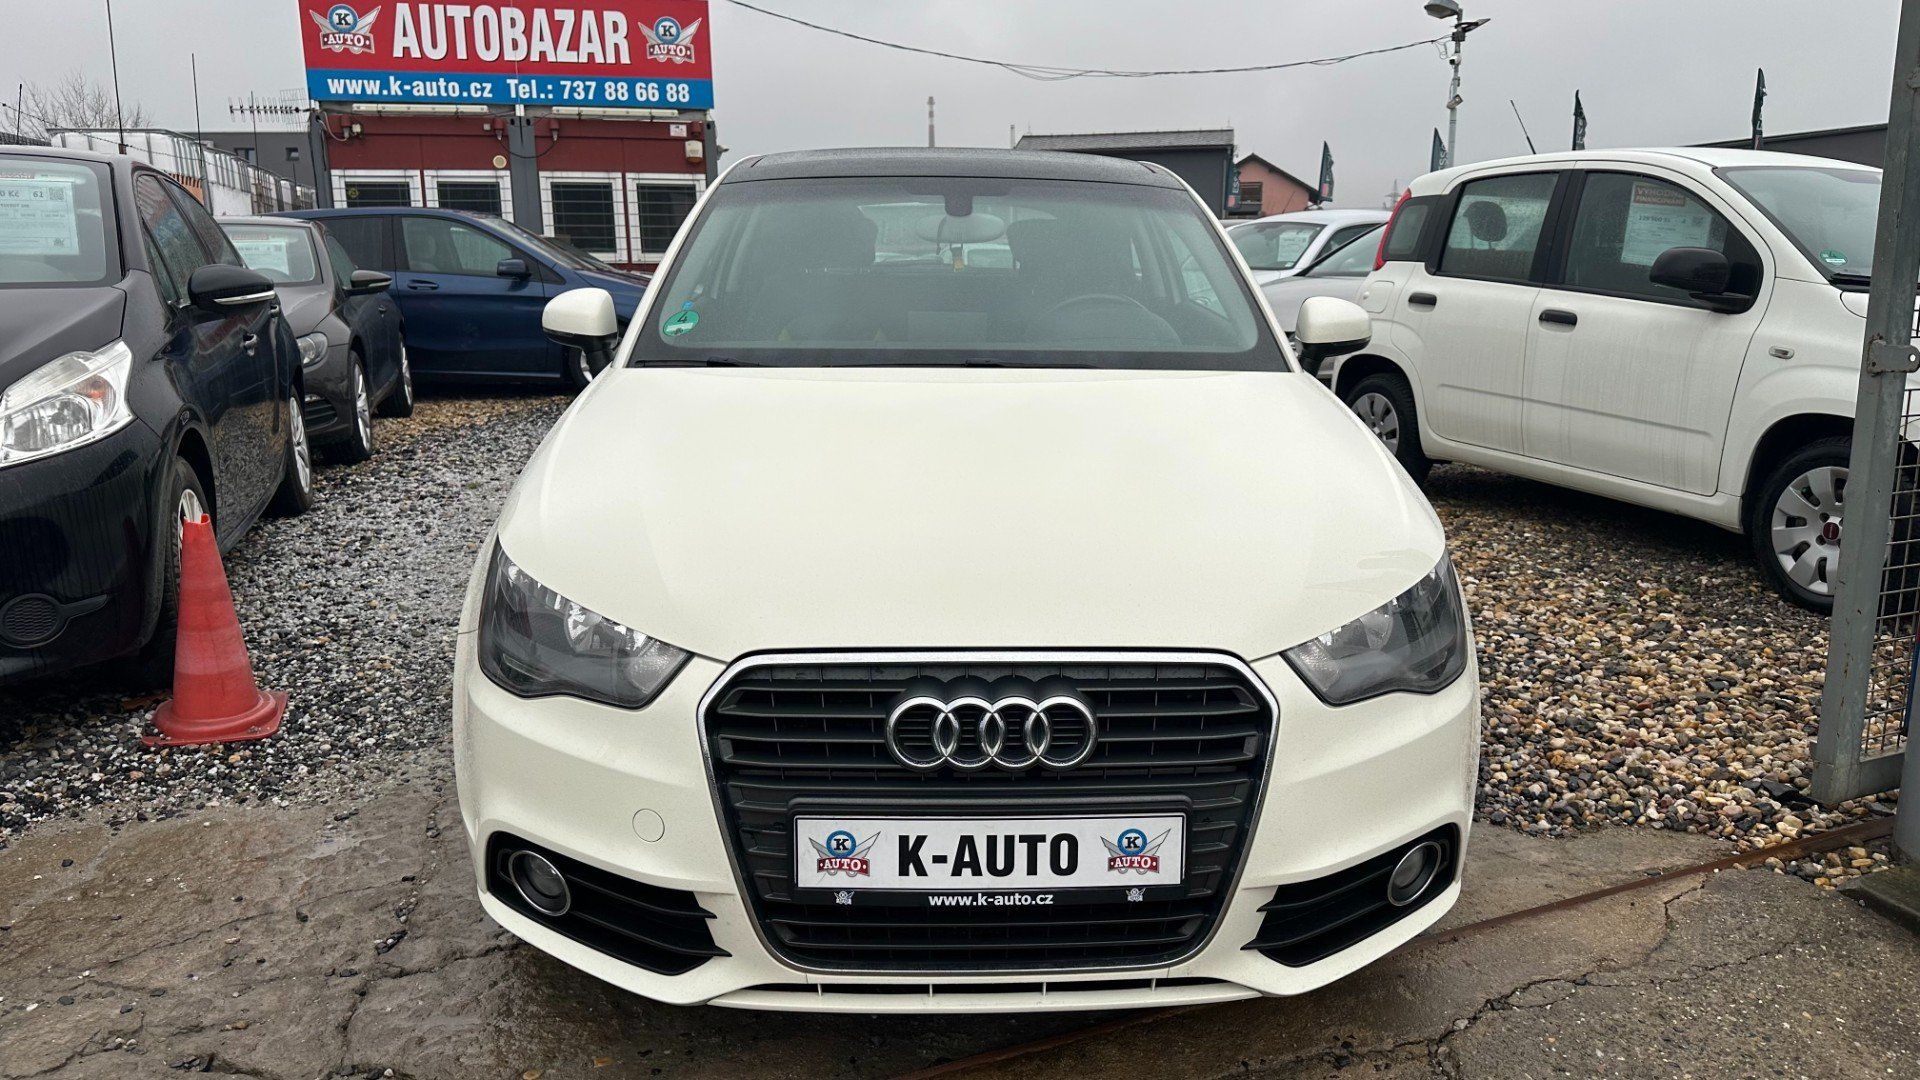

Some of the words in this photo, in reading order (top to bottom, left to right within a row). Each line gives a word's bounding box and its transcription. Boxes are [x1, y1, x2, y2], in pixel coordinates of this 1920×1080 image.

[335, 13, 350, 25] K
[393, 2, 632, 65] AUTOBAZAR
[660, 25, 674, 37] K
[328, 33, 365, 47] AUTO
[652, 44, 686, 57] AUTO
[327, 75, 493, 98] www.k-auto.cz
[506, 78, 553, 99] Tel.:
[560, 80, 596, 100] 737
[604, 81, 629, 101] 88
[635, 82, 659, 101] 66
[666, 83, 690, 102] 88
[33, 190, 44, 198] 61
[833, 838, 849, 851] K
[1124, 836, 1140, 849] K
[898, 833, 1079, 877] K-AUTO
[823, 858, 862, 871] AUTO
[1114, 856, 1152, 868] AUTO
[928, 892, 1054, 906] www.k-auto.cz
